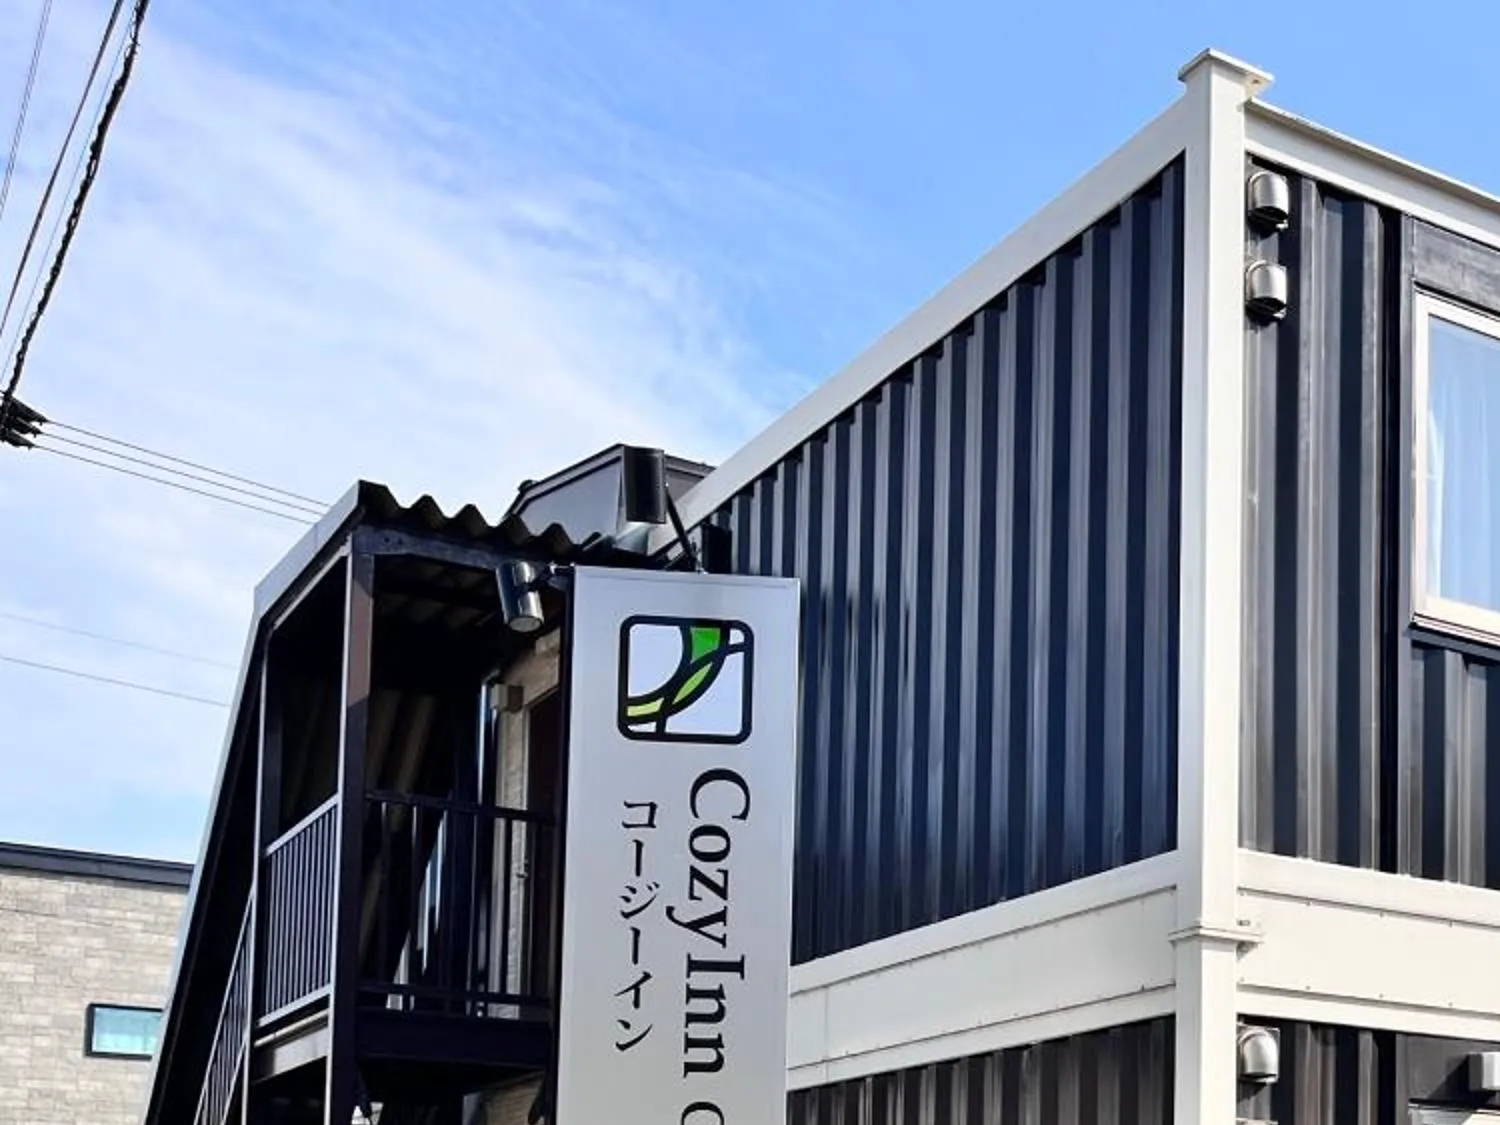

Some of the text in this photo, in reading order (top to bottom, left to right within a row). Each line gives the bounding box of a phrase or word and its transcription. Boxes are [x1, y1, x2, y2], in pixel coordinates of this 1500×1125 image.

[615, 801, 660, 1052] コージーイン
